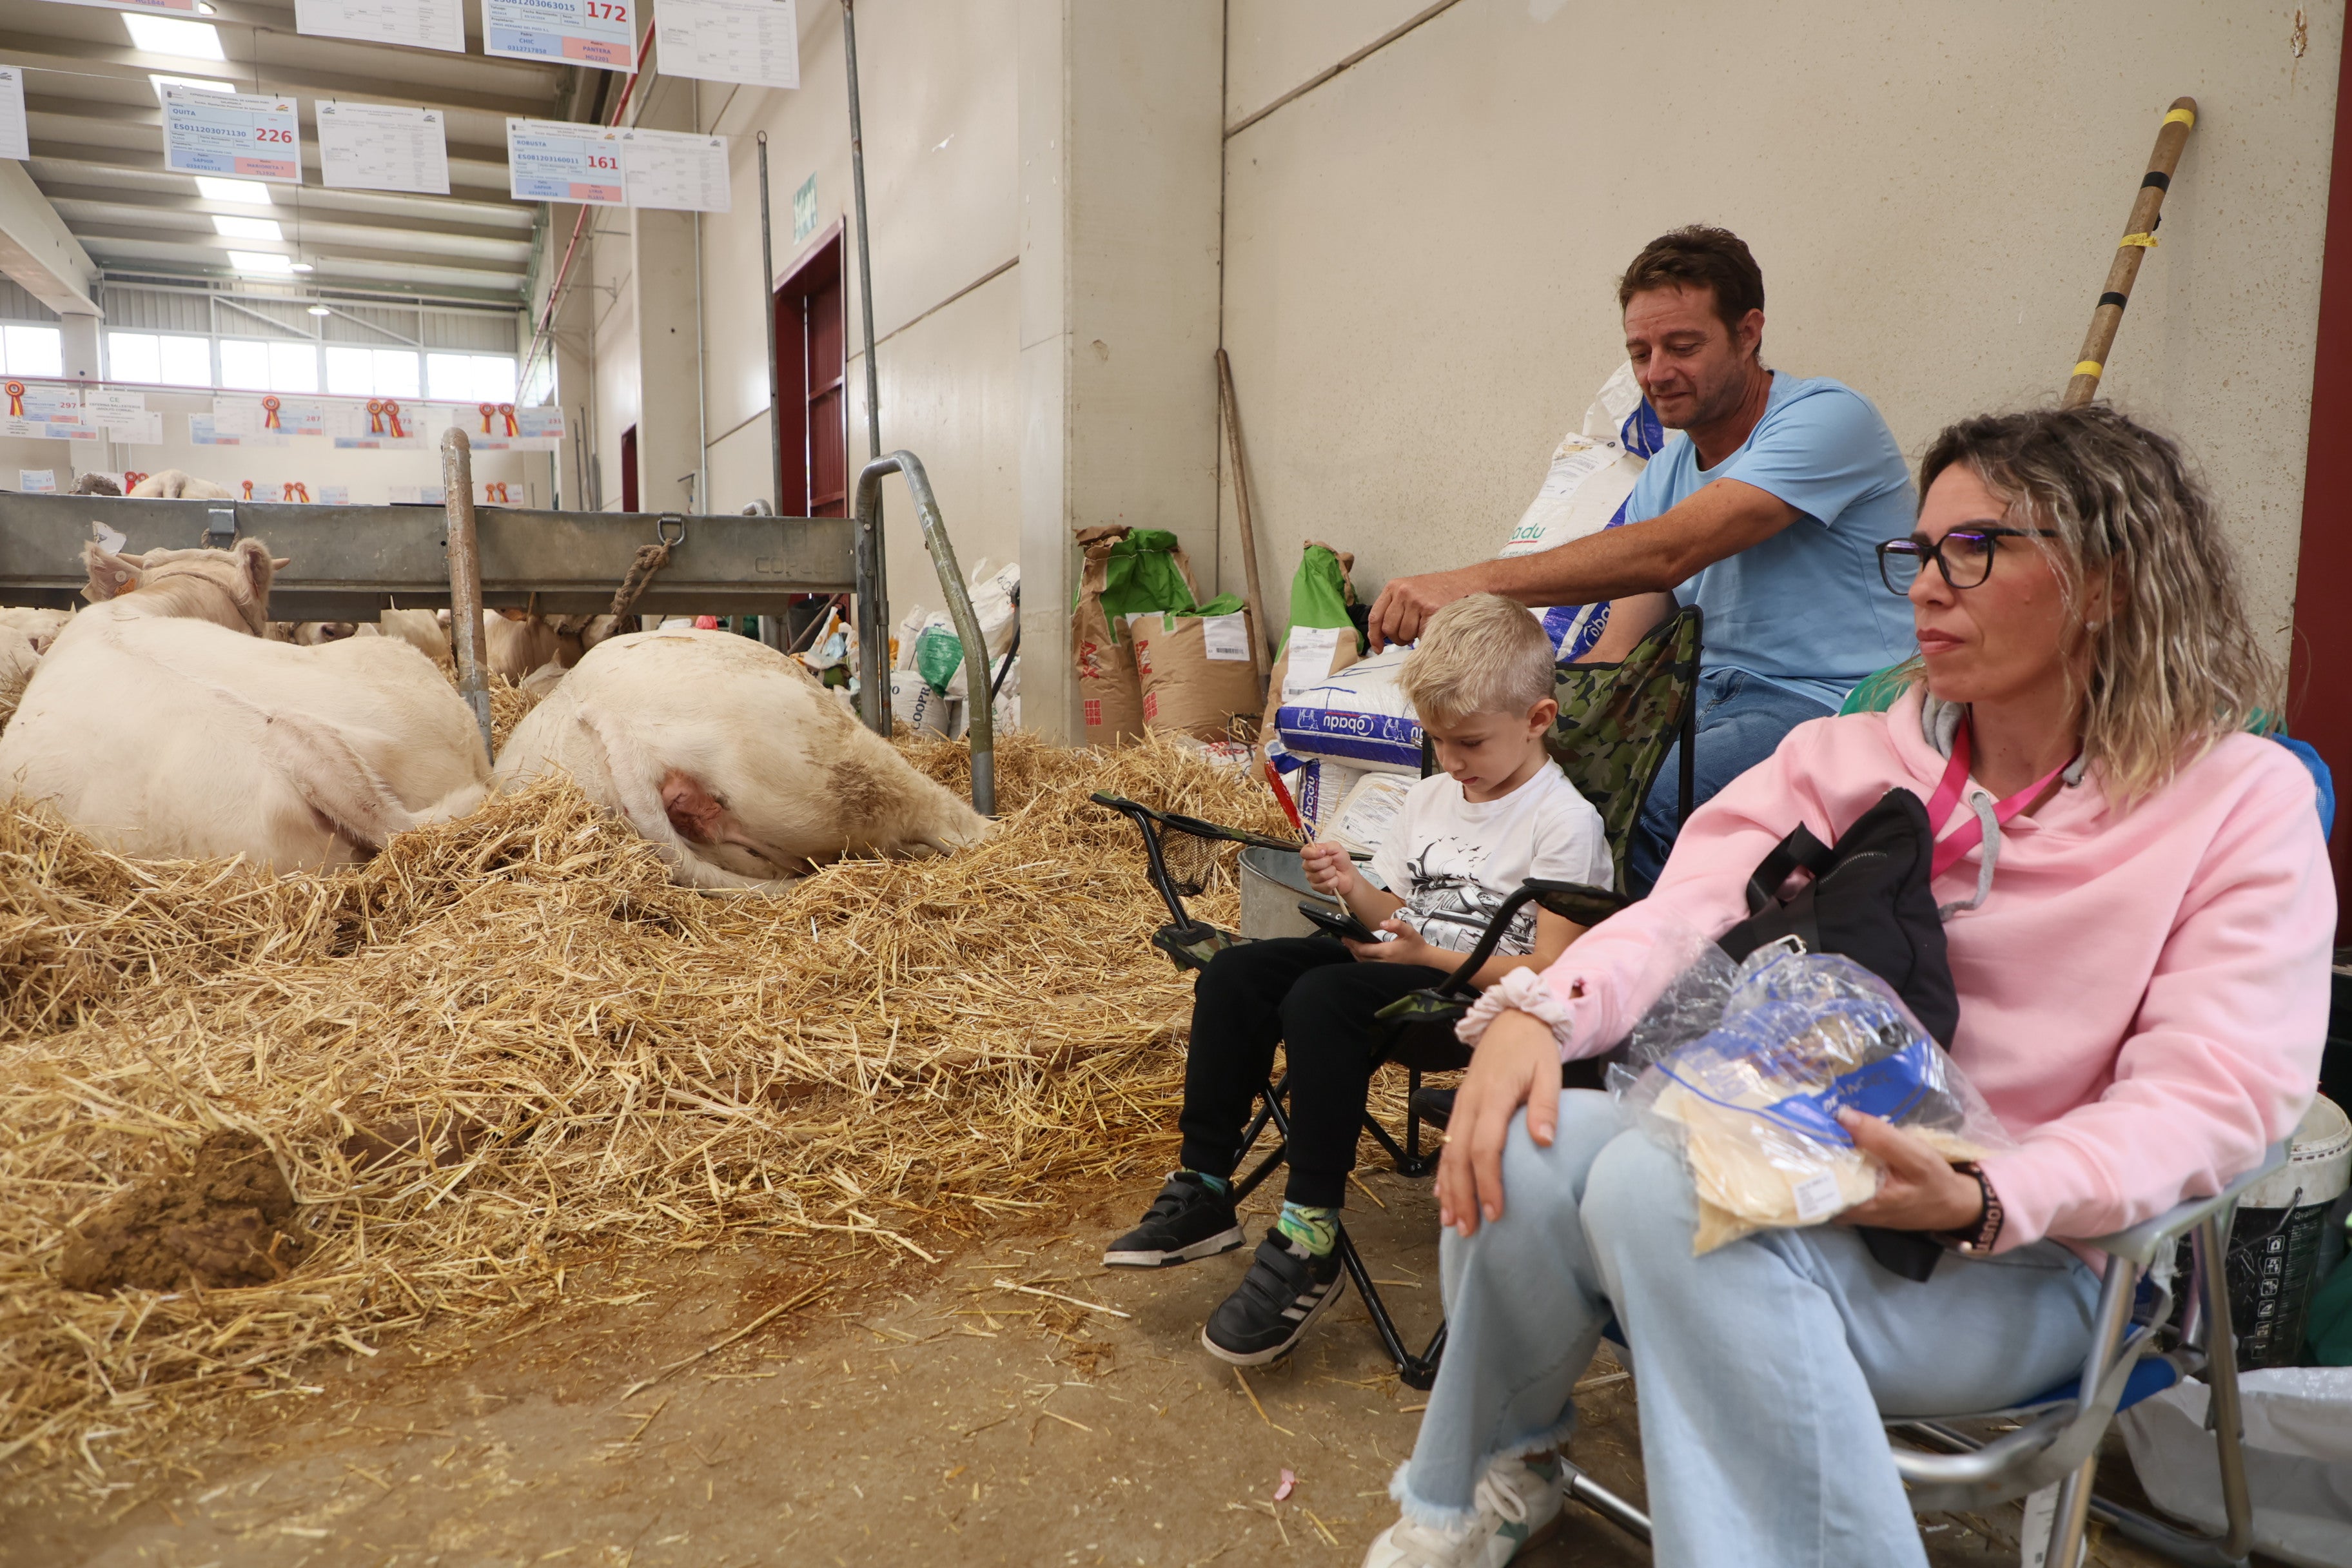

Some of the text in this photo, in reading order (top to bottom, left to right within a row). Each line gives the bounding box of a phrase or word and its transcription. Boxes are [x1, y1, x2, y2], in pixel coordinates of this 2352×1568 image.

[587, 1, 627, 23] 172
[582, 45, 612, 55] PANTERA
[172, 108, 197, 116] QUITA
[173, 122, 247, 137] ES011203071130
[255, 128, 293, 144] 226
[587, 155, 619, 170] 161
[1323, 714, 1375, 736] Cobadu
